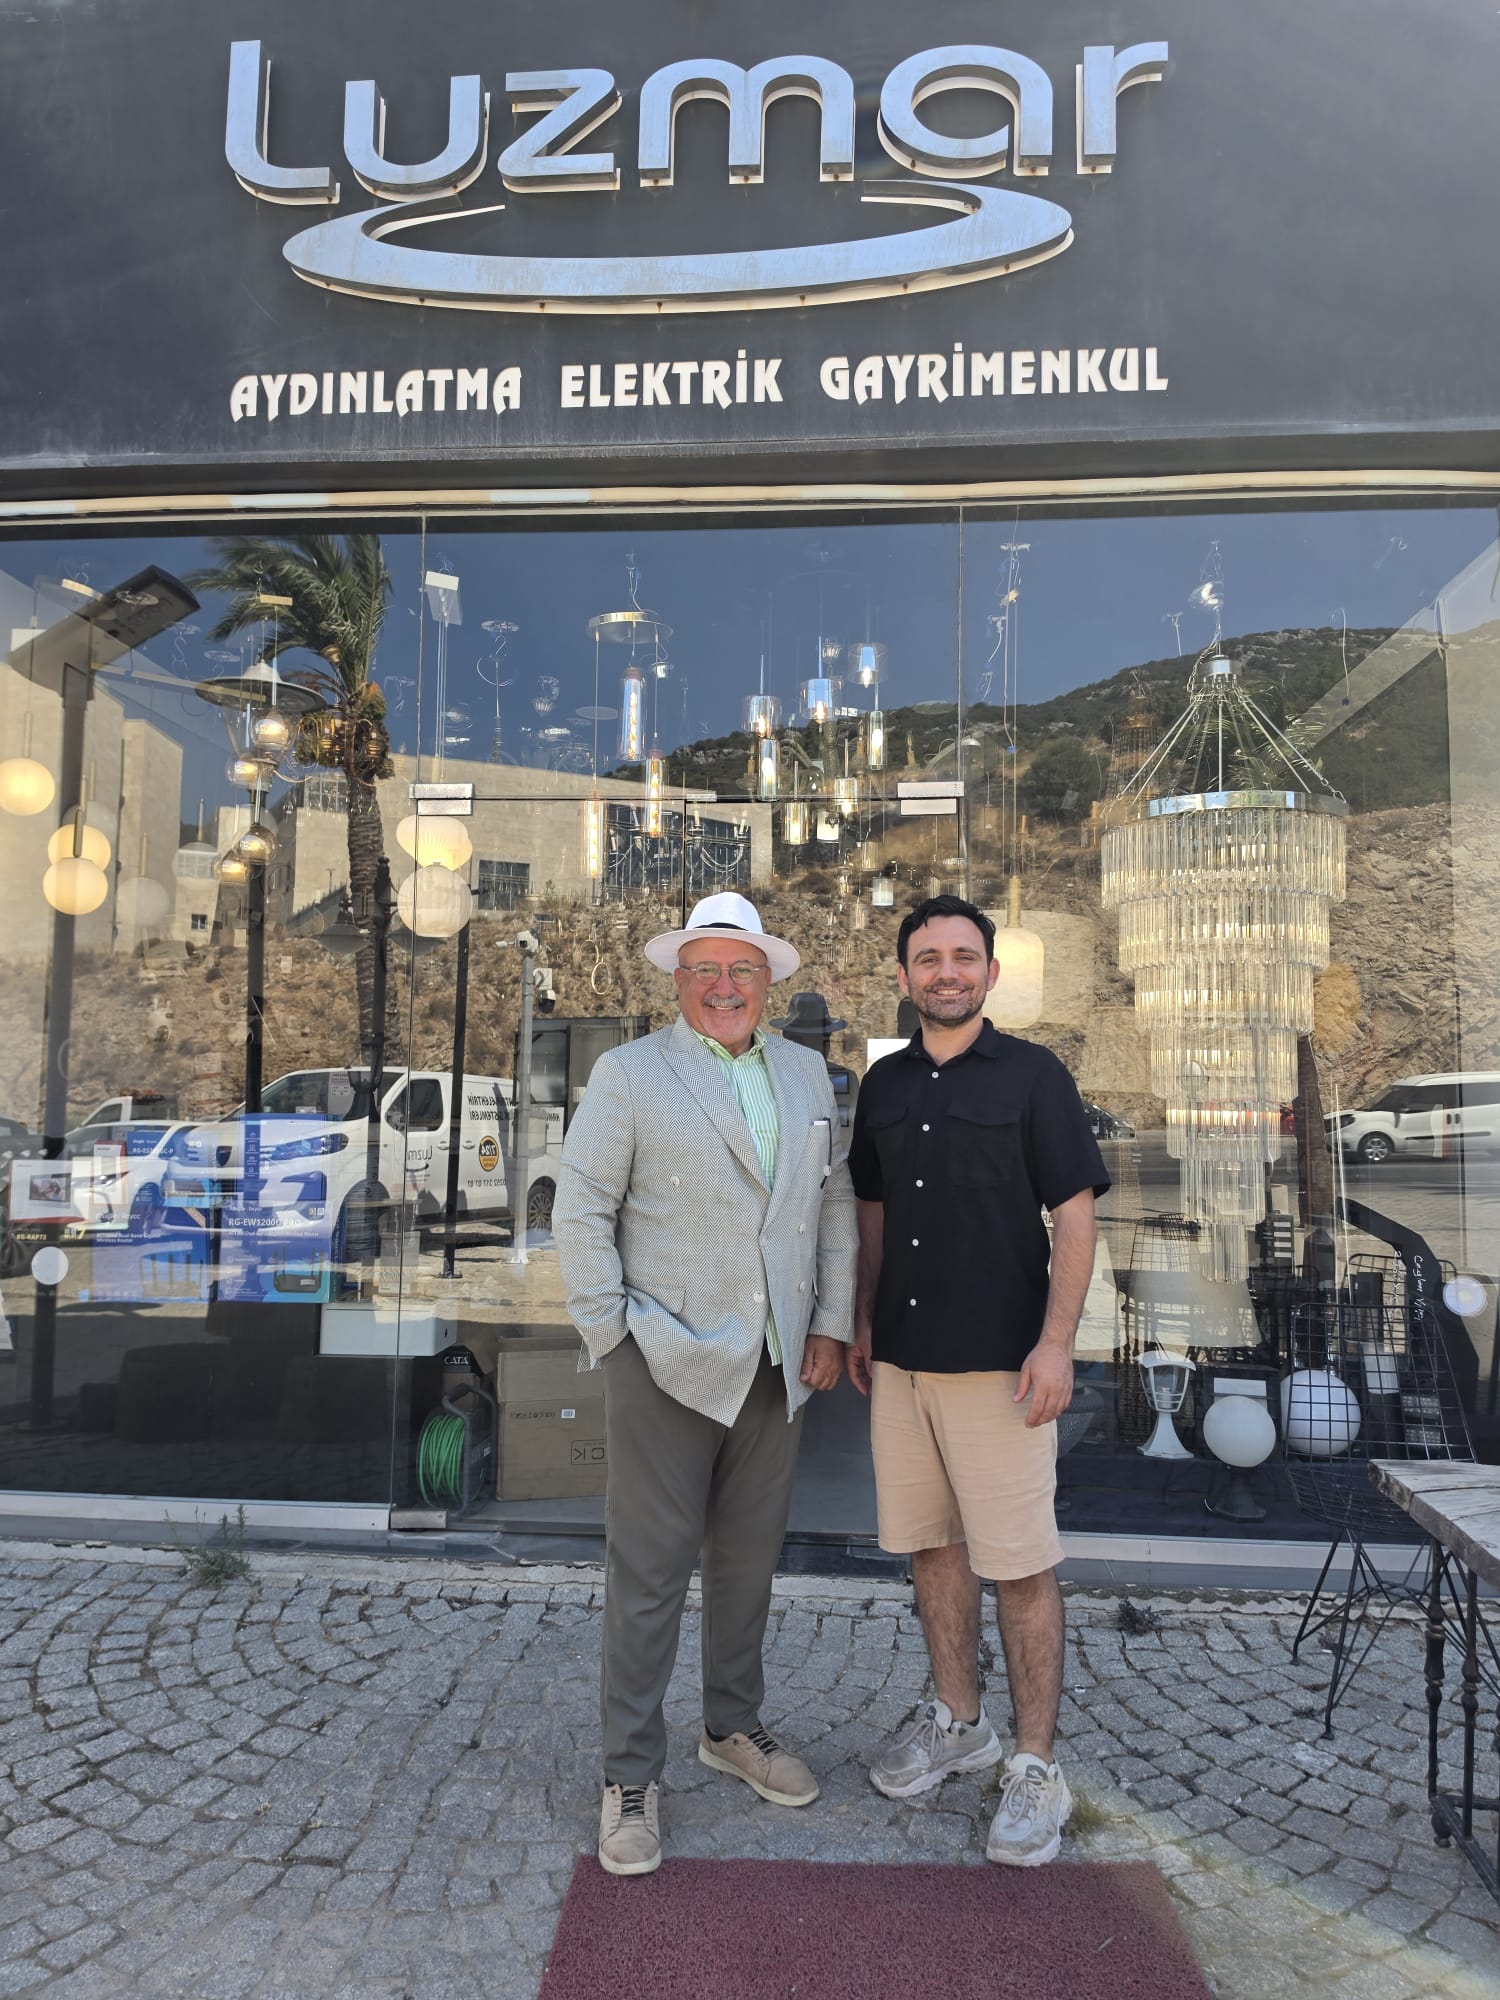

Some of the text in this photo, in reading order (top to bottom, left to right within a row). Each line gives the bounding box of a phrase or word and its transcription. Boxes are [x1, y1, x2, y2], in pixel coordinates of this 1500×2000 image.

[225, 39, 1169, 205] Luzmar
[229, 341, 1169, 423] AYDINLATMA ELEKTRİK GAYRİMENKUL
